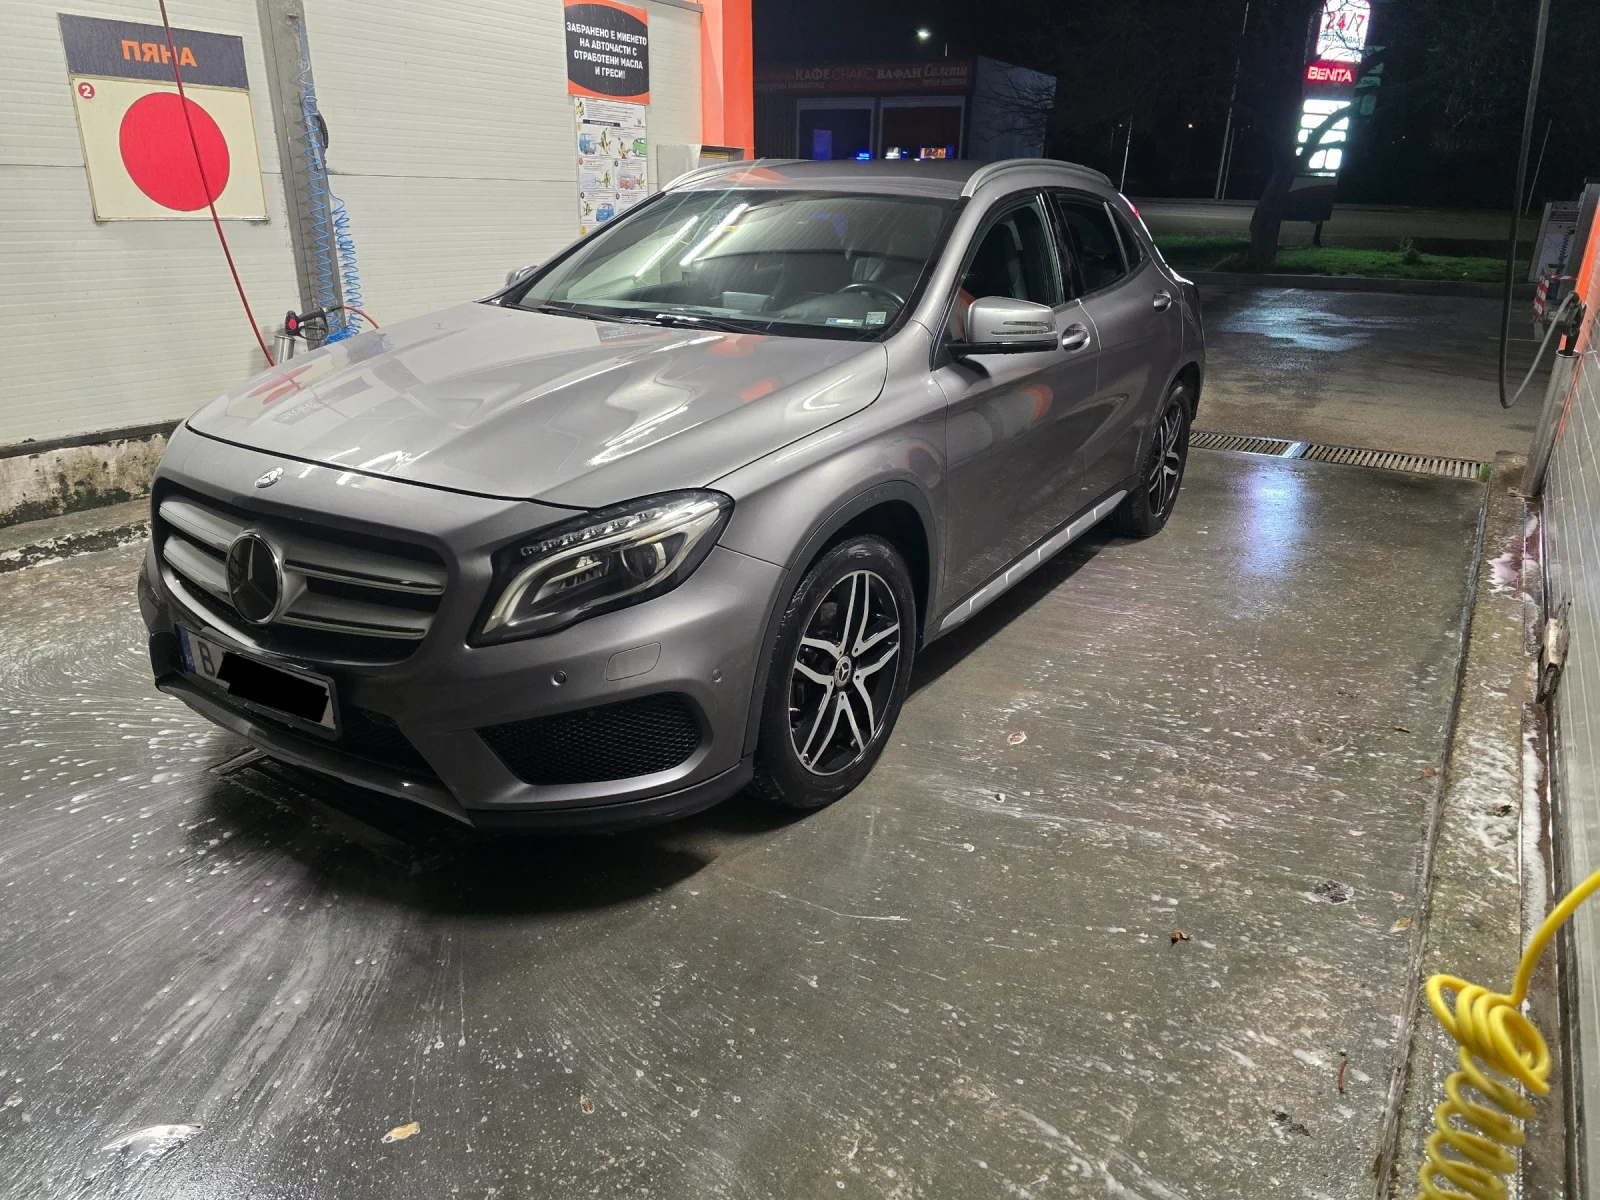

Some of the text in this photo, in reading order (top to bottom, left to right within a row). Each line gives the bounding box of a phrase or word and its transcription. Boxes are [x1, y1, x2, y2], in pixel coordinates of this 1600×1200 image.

[1325, 11, 1365, 32] 24/7
[566, 22, 647, 46] ЗАБРАНЕНО Е МИЕНЕТО
[121, 40, 198, 68] ПЯНА
[579, 38, 637, 56] НА АВТОЧАСТИ С
[573, 50, 643, 70] ОТРАБОТЕНИ МАСЛА
[595, 66, 626, 79] И ГРЕСИ!
[795, 68, 829, 81] КАФЕ
[831, 67, 874, 80] СНАКС
[877, 67, 921, 80] ВАФЛИ
[924, 63, 968, 77] Солети
[1308, 66, 1352, 82] BENITA
[81, 85, 92, 97] 2
[197, 640, 216, 677] B
